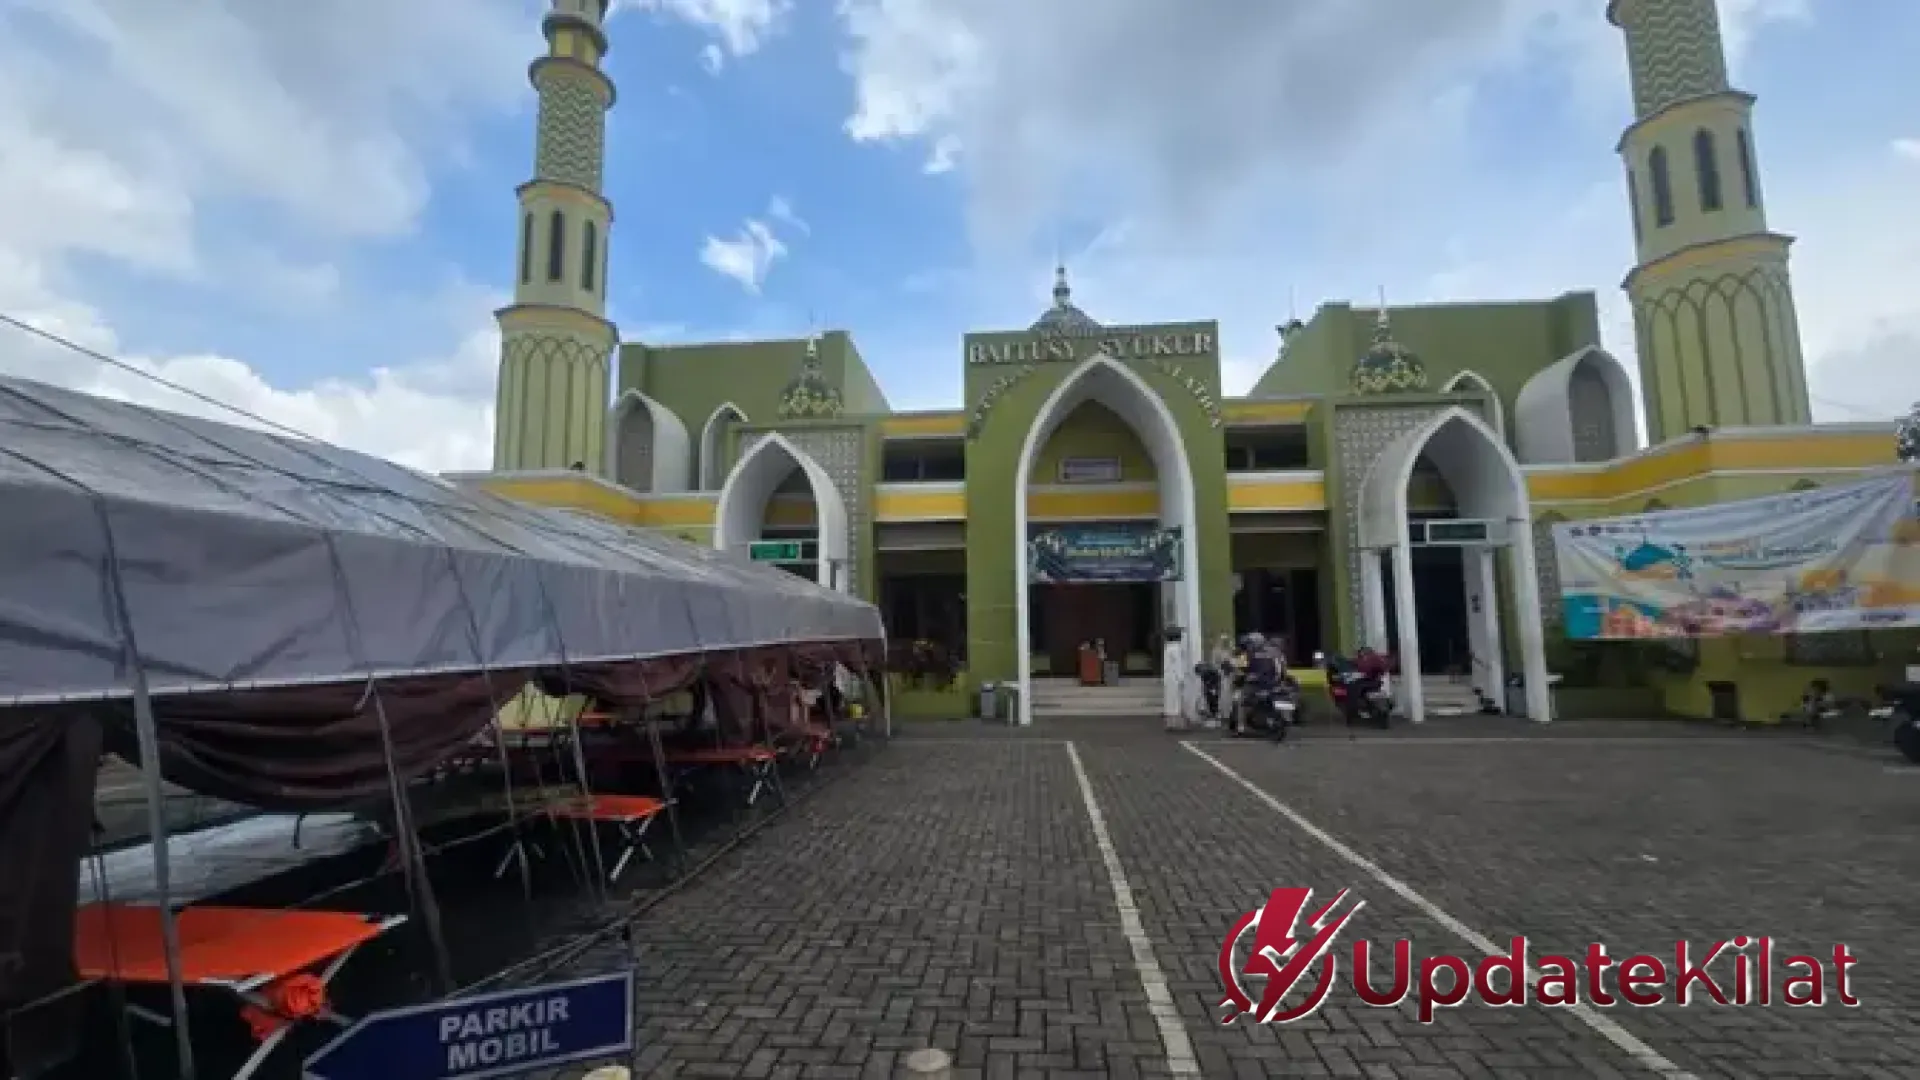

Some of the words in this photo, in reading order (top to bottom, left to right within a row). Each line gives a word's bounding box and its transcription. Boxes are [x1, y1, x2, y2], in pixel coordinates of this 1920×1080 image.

[1099, 332, 1211, 356] SYUKUR
[439, 997, 569, 1041] PARKIR
[447, 1028, 560, 1070] MOBIL
